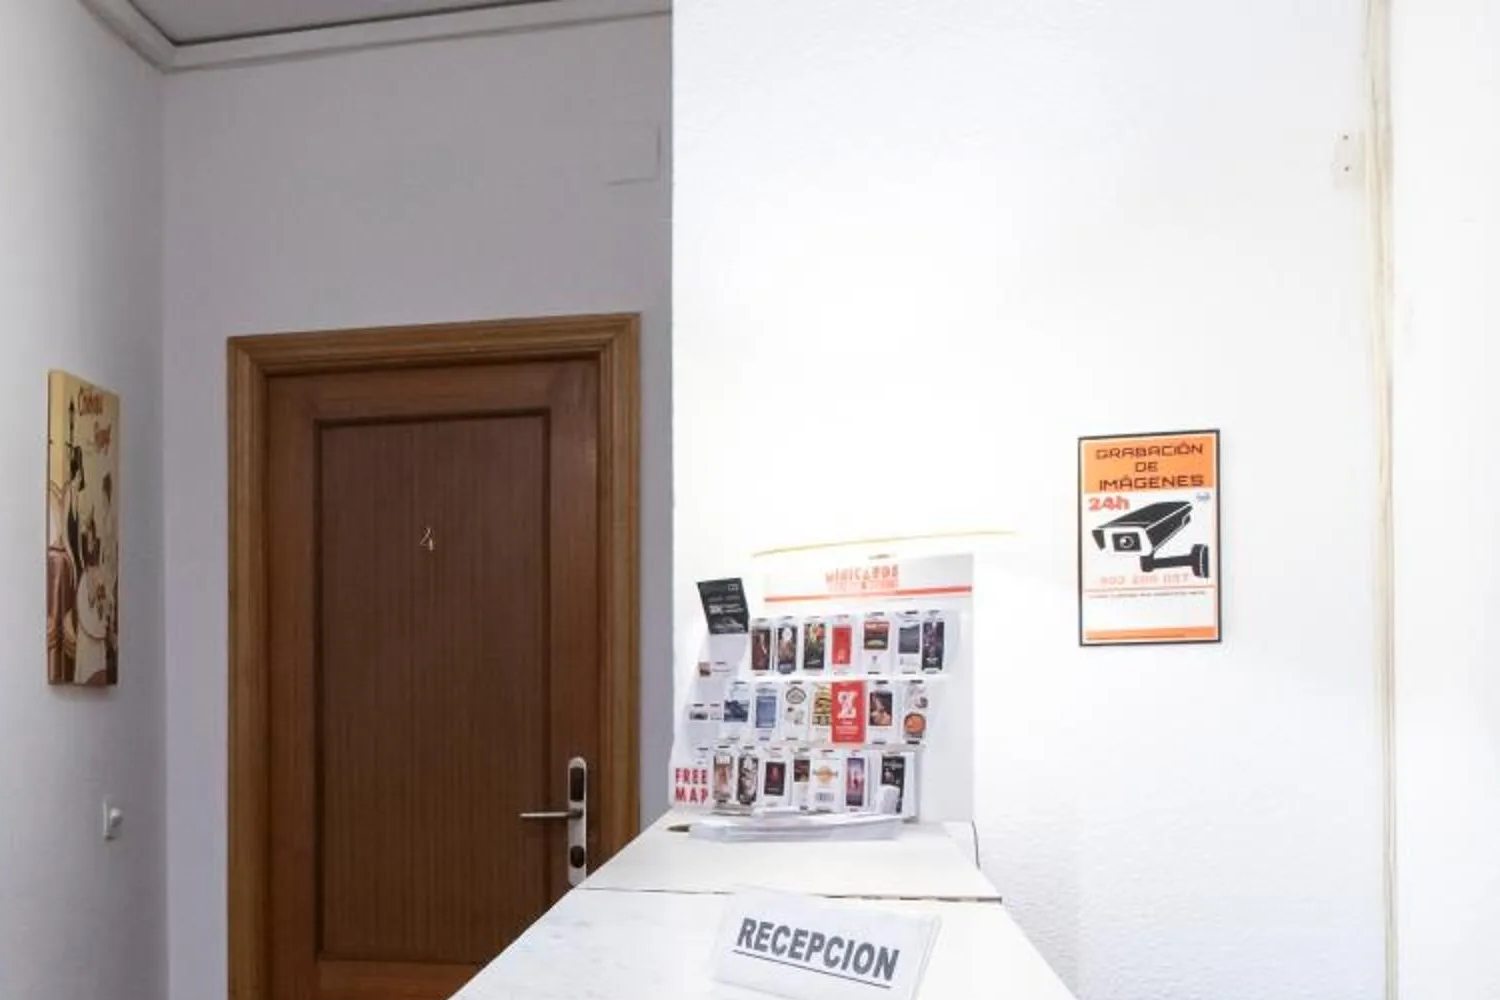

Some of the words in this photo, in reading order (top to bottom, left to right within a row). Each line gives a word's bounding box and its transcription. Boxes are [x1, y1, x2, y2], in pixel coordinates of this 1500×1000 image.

[1095, 442, 1204, 460] GRABACIÓN
[1134, 461, 1159, 474] DE
[1098, 474, 1205, 492] IMÁGENES
[1088, 495, 1130, 512] 24h
[675, 767, 709, 785] FREE
[675, 786, 709, 804] MAP
[736, 917, 900, 981] RECEPCION
